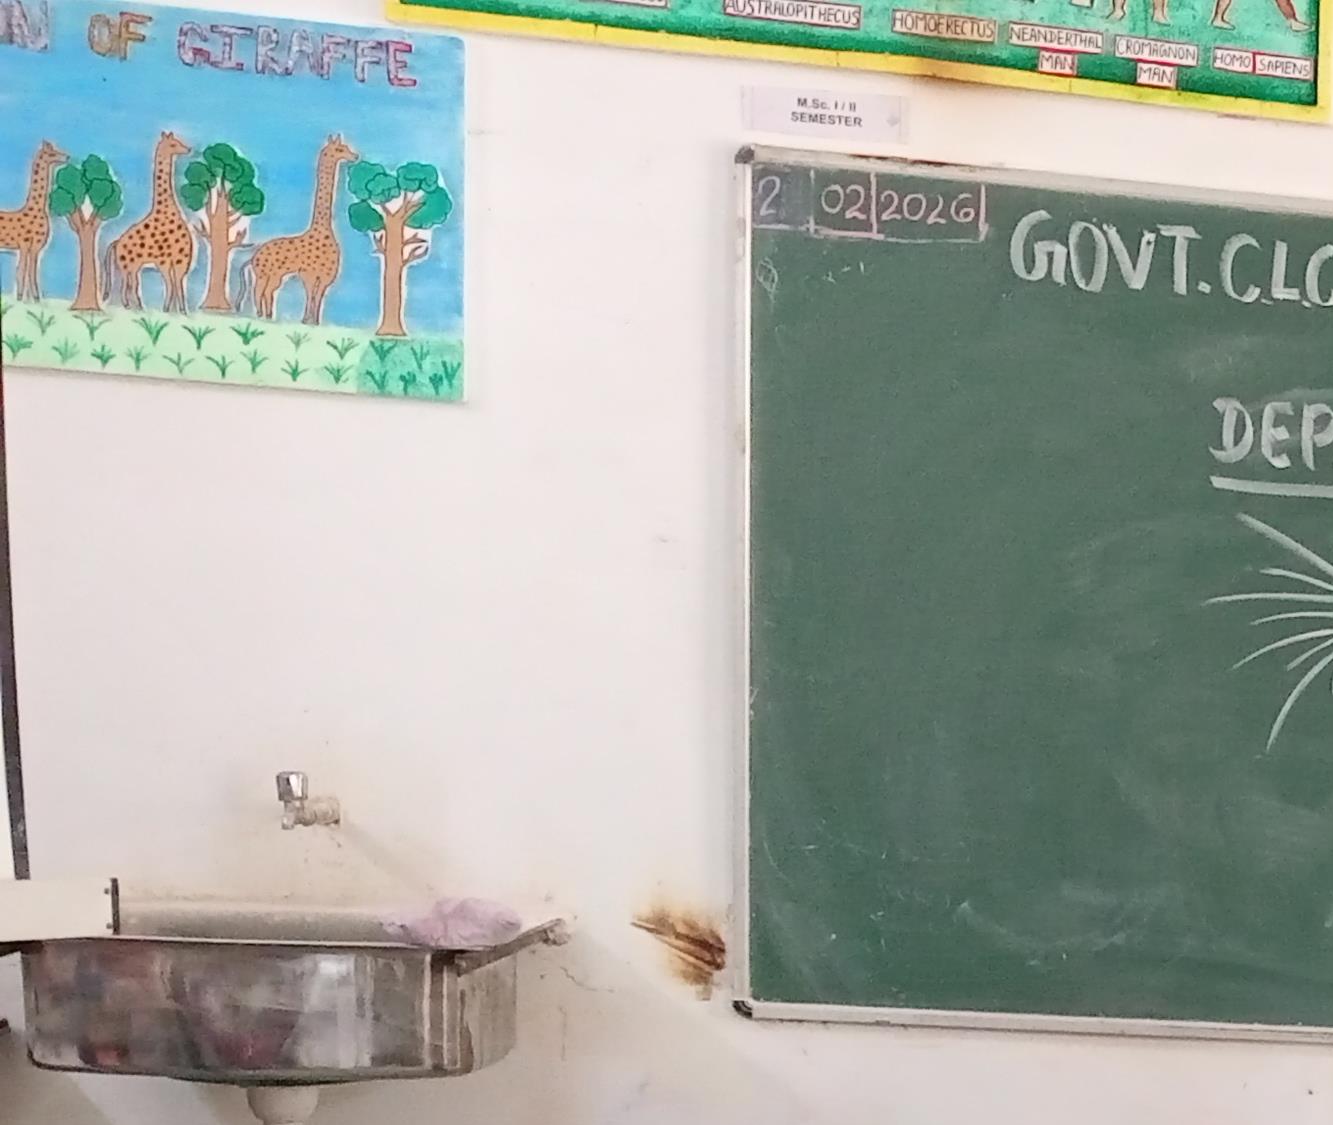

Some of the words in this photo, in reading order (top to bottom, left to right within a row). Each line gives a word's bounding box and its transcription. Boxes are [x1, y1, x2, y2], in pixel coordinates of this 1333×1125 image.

[87, 11, 152, 61] OF
[176, 21, 418, 87] GIRAFFE
[1009, 24, 1102, 50] NEANDERTHAL
[1117, 37, 1197, 62] CROMAGNON
[1041, 52, 1074, 72] MAN
[1139, 64, 1175, 84] MAN
[1214, 51, 1251, 69] HOMO
[1258, 57, 1312, 77] SAPIENS
[791, 111, 863, 127] SEMESTER
[820, 183, 867, 220] 02
[881, 190, 975, 224] 2026
